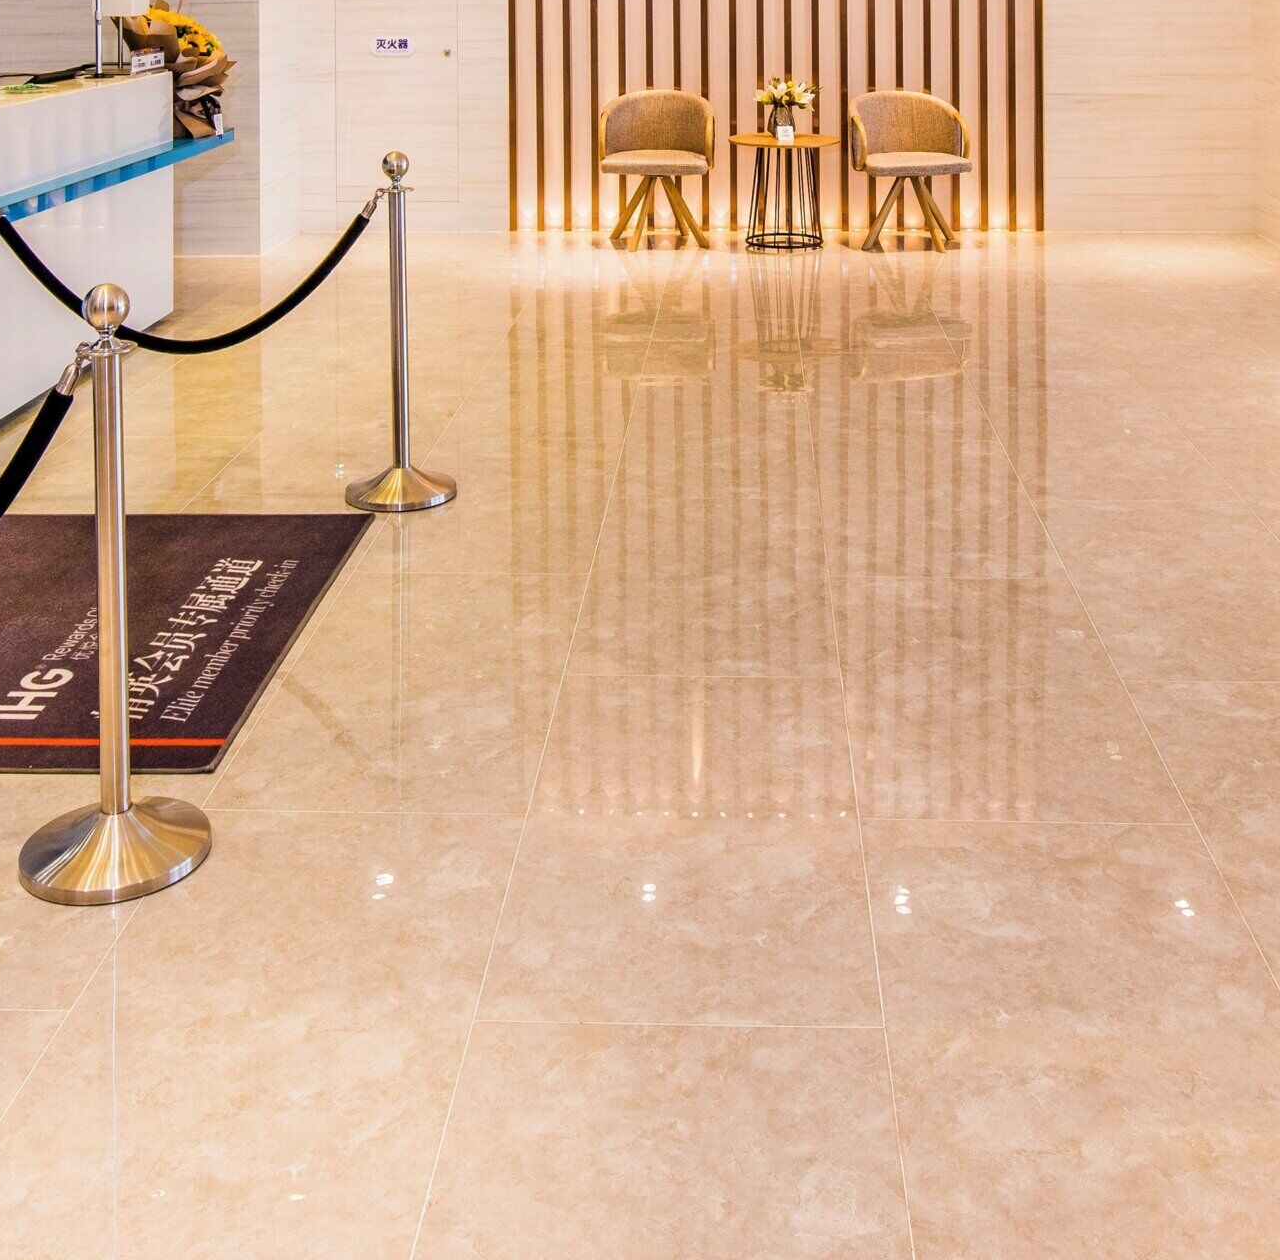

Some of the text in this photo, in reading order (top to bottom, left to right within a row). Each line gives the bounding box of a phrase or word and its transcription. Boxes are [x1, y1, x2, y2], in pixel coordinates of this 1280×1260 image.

[376, 39, 409, 50] 灭火器
[42, 618, 98, 661] Rewards
[159, 559, 300, 722] Elite member priority check-in
